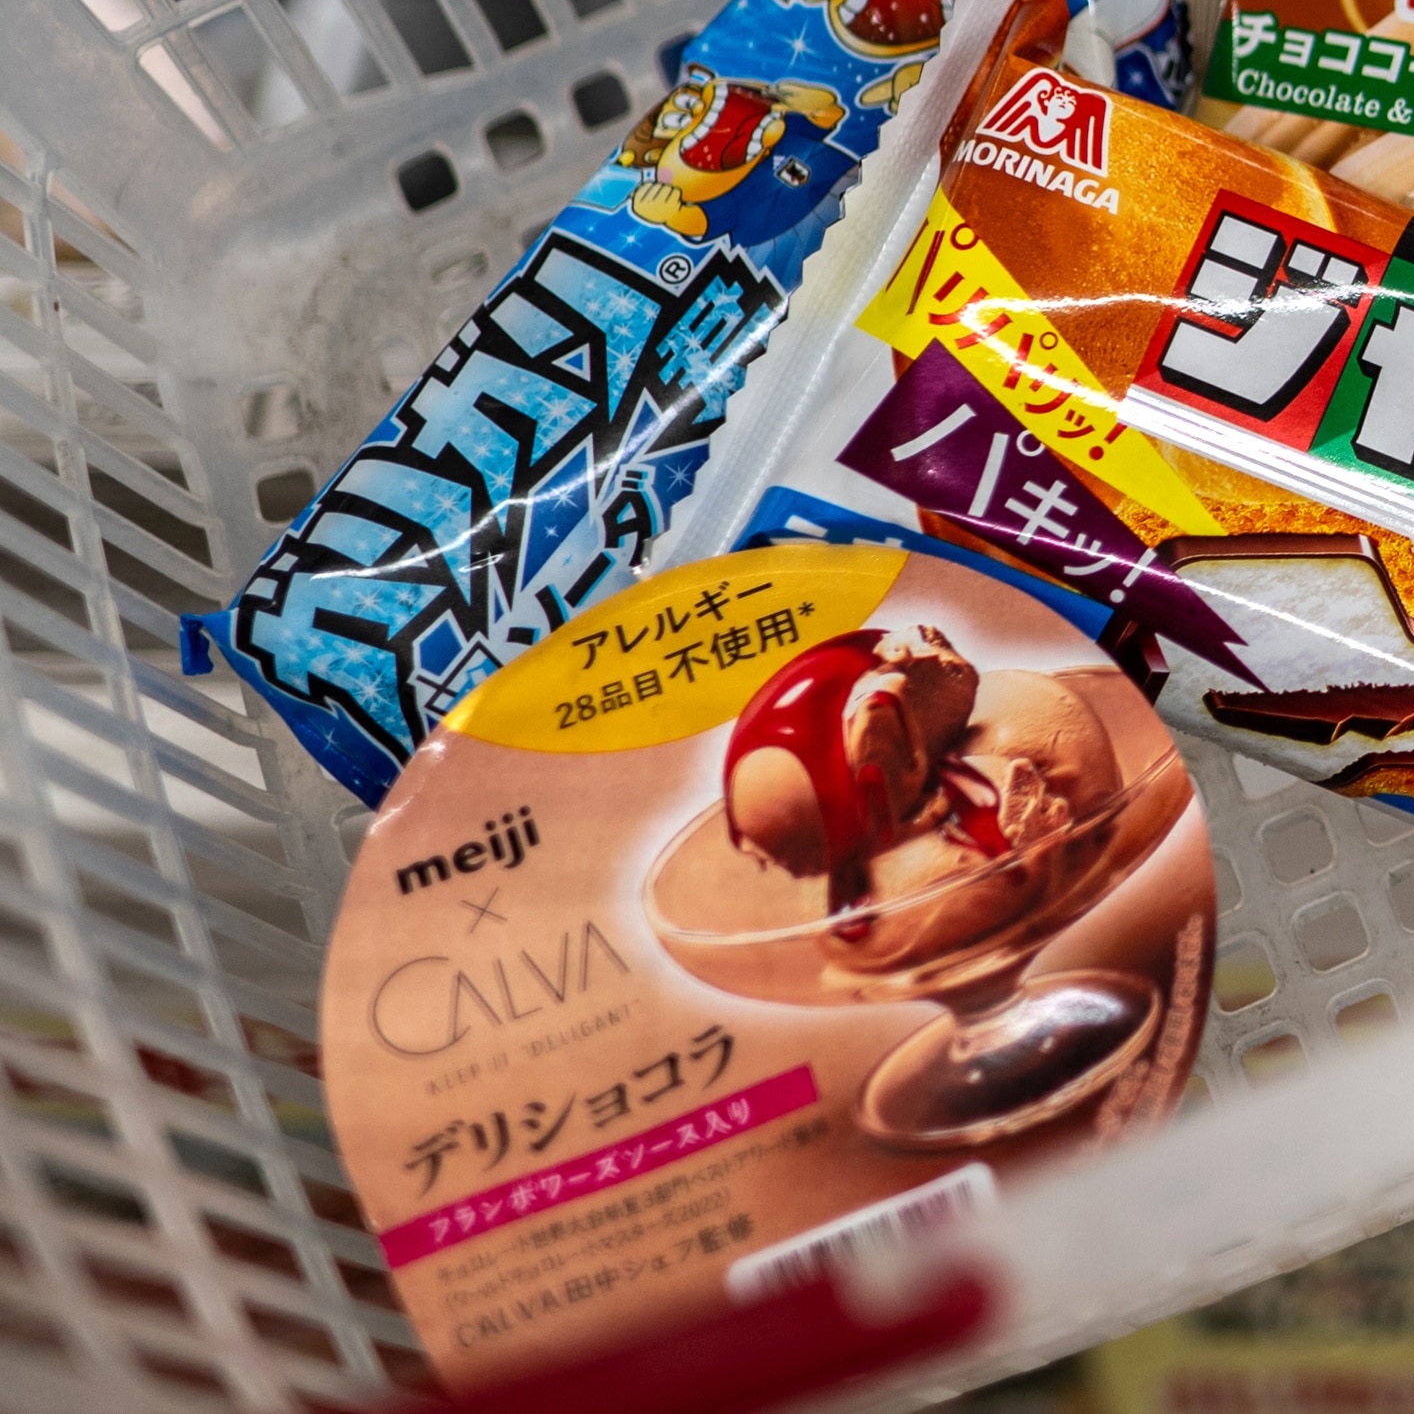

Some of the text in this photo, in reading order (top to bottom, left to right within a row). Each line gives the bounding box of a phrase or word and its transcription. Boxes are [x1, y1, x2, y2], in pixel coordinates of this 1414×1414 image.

[1237, 67, 1381, 119] Chocolate
[1387, 99, 1413, 125] &
[953, 139, 1120, 216] MORINAGA
[891, 404, 1157, 604] パキッ!
[572, 577, 775, 670] アレルギー
[394, 805, 541, 896] meiji
[373, 921, 631, 1057] CALVA
[405, 1025, 735, 1200] デリショコラ
